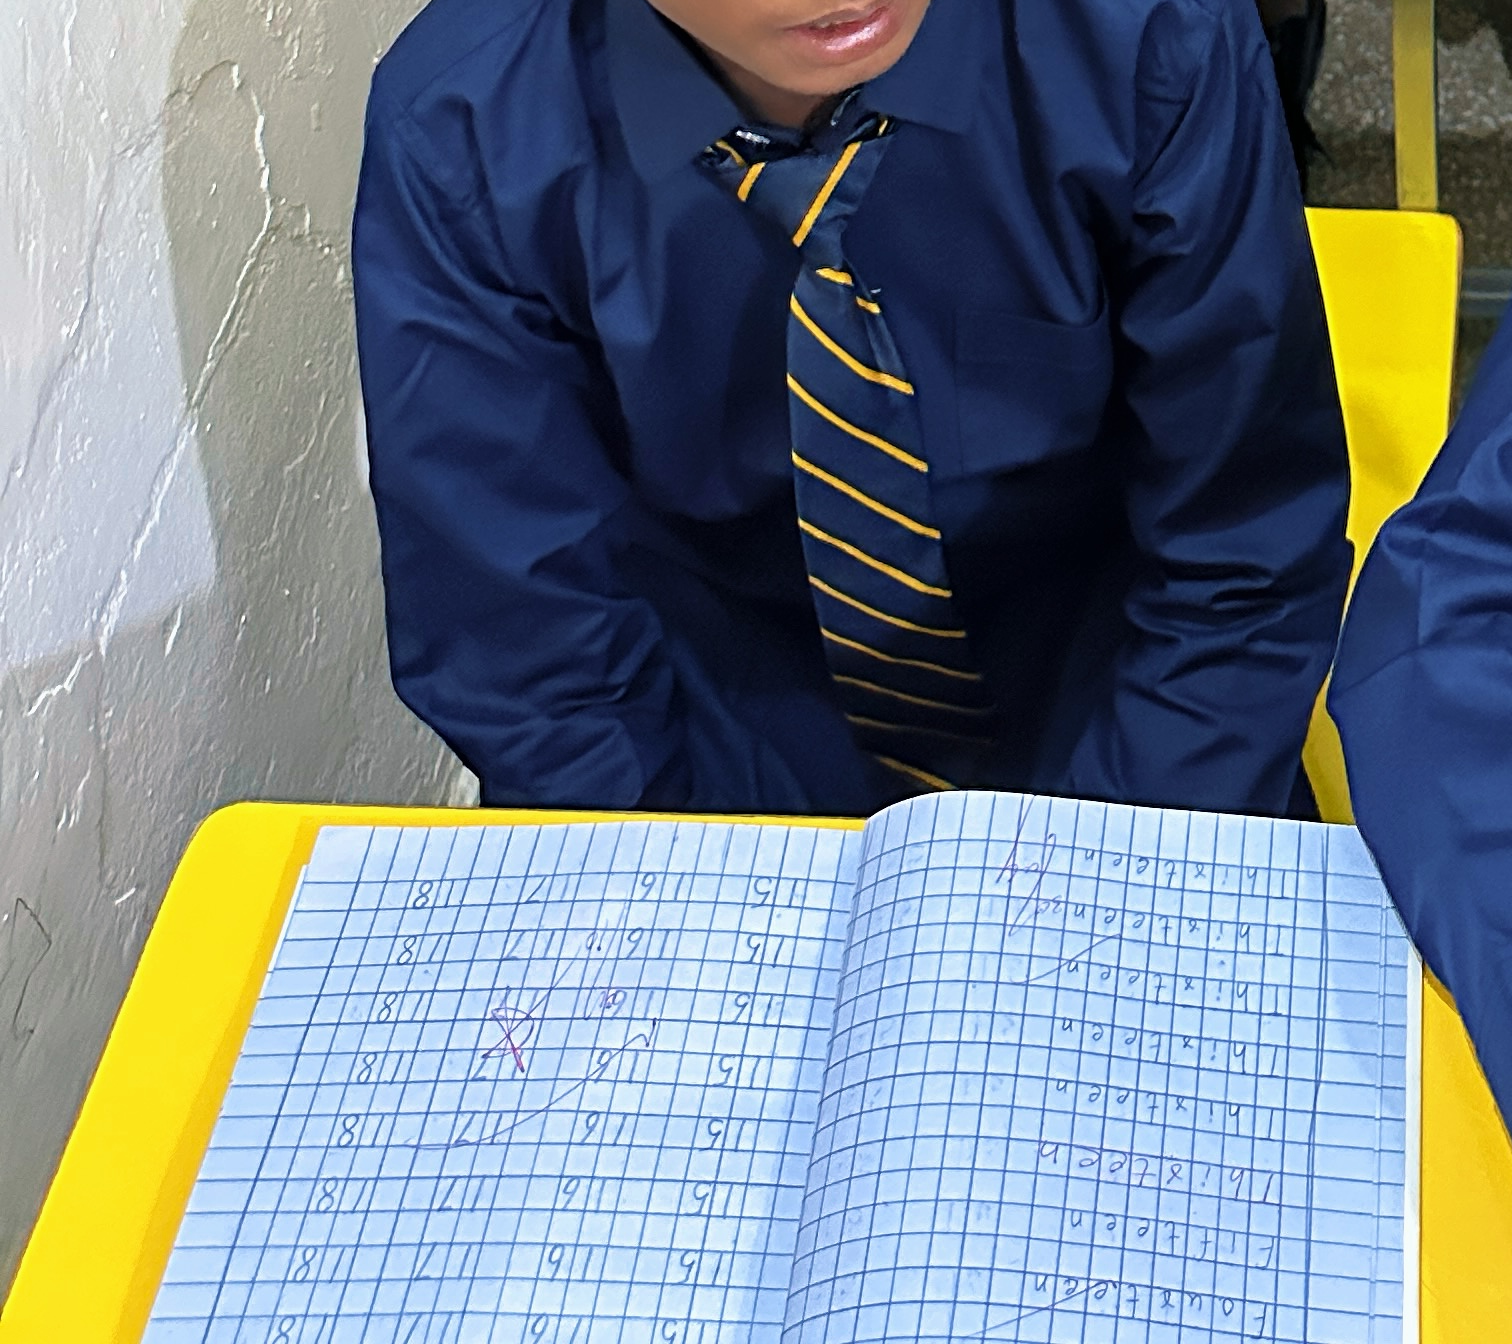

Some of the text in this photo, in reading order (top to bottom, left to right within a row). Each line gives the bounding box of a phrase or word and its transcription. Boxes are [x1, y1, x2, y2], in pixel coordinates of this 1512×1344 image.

[412, 872, 797, 910] 15 16 17 18
[396, 934, 440, 966] 18
[627, 928, 669, 960] 16
[745, 933, 789, 967] 15
[377, 991, 424, 1024] 18
[733, 991, 774, 1024] 15
[354, 1050, 404, 1085] 18
[593, 1049, 638, 1083] 16
[716, 1054, 760, 1090] 15
[336, 1113, 385, 1148] 18
[582, 1112, 629, 1147] 16
[697, 1118, 746, 1152] 15
[321, 1176, 733, 1214] 15 16 17 18
[1067, 1210, 1277, 1271] Fifteen
[293, 1241, 723, 1287] 15 16 17 18
